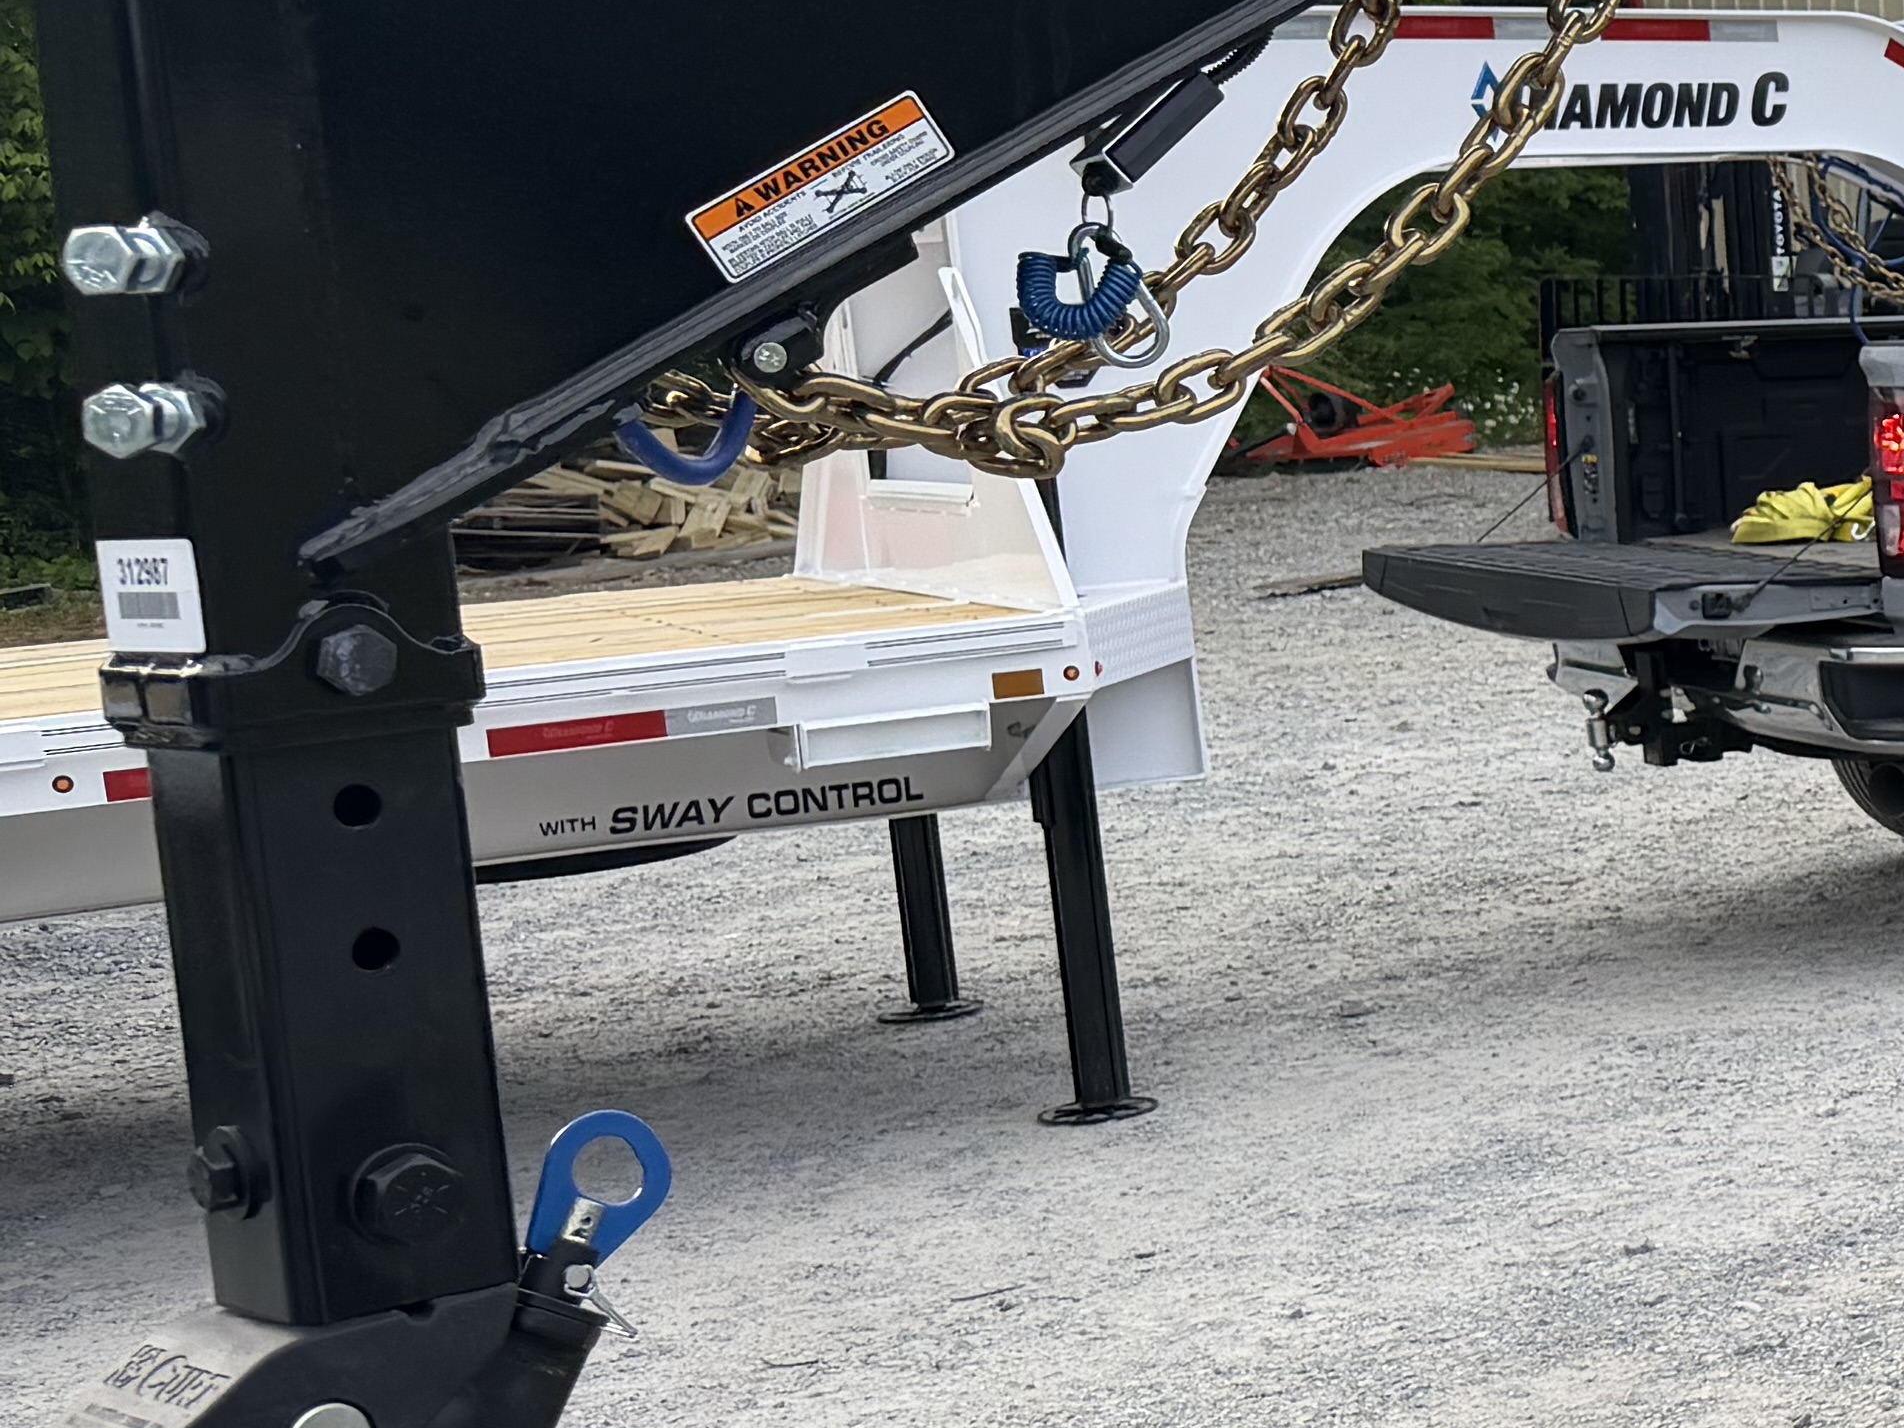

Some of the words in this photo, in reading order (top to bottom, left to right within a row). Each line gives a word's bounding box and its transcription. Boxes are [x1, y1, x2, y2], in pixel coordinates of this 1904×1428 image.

[1751, 71, 1790, 127] C
[753, 119, 890, 202] WARNING
[1773, 189, 1785, 257] TOYOTA
[539, 815, 597, 838] WITH
[608, 795, 737, 836] SWAY
[746, 775, 925, 820] CONTROL
